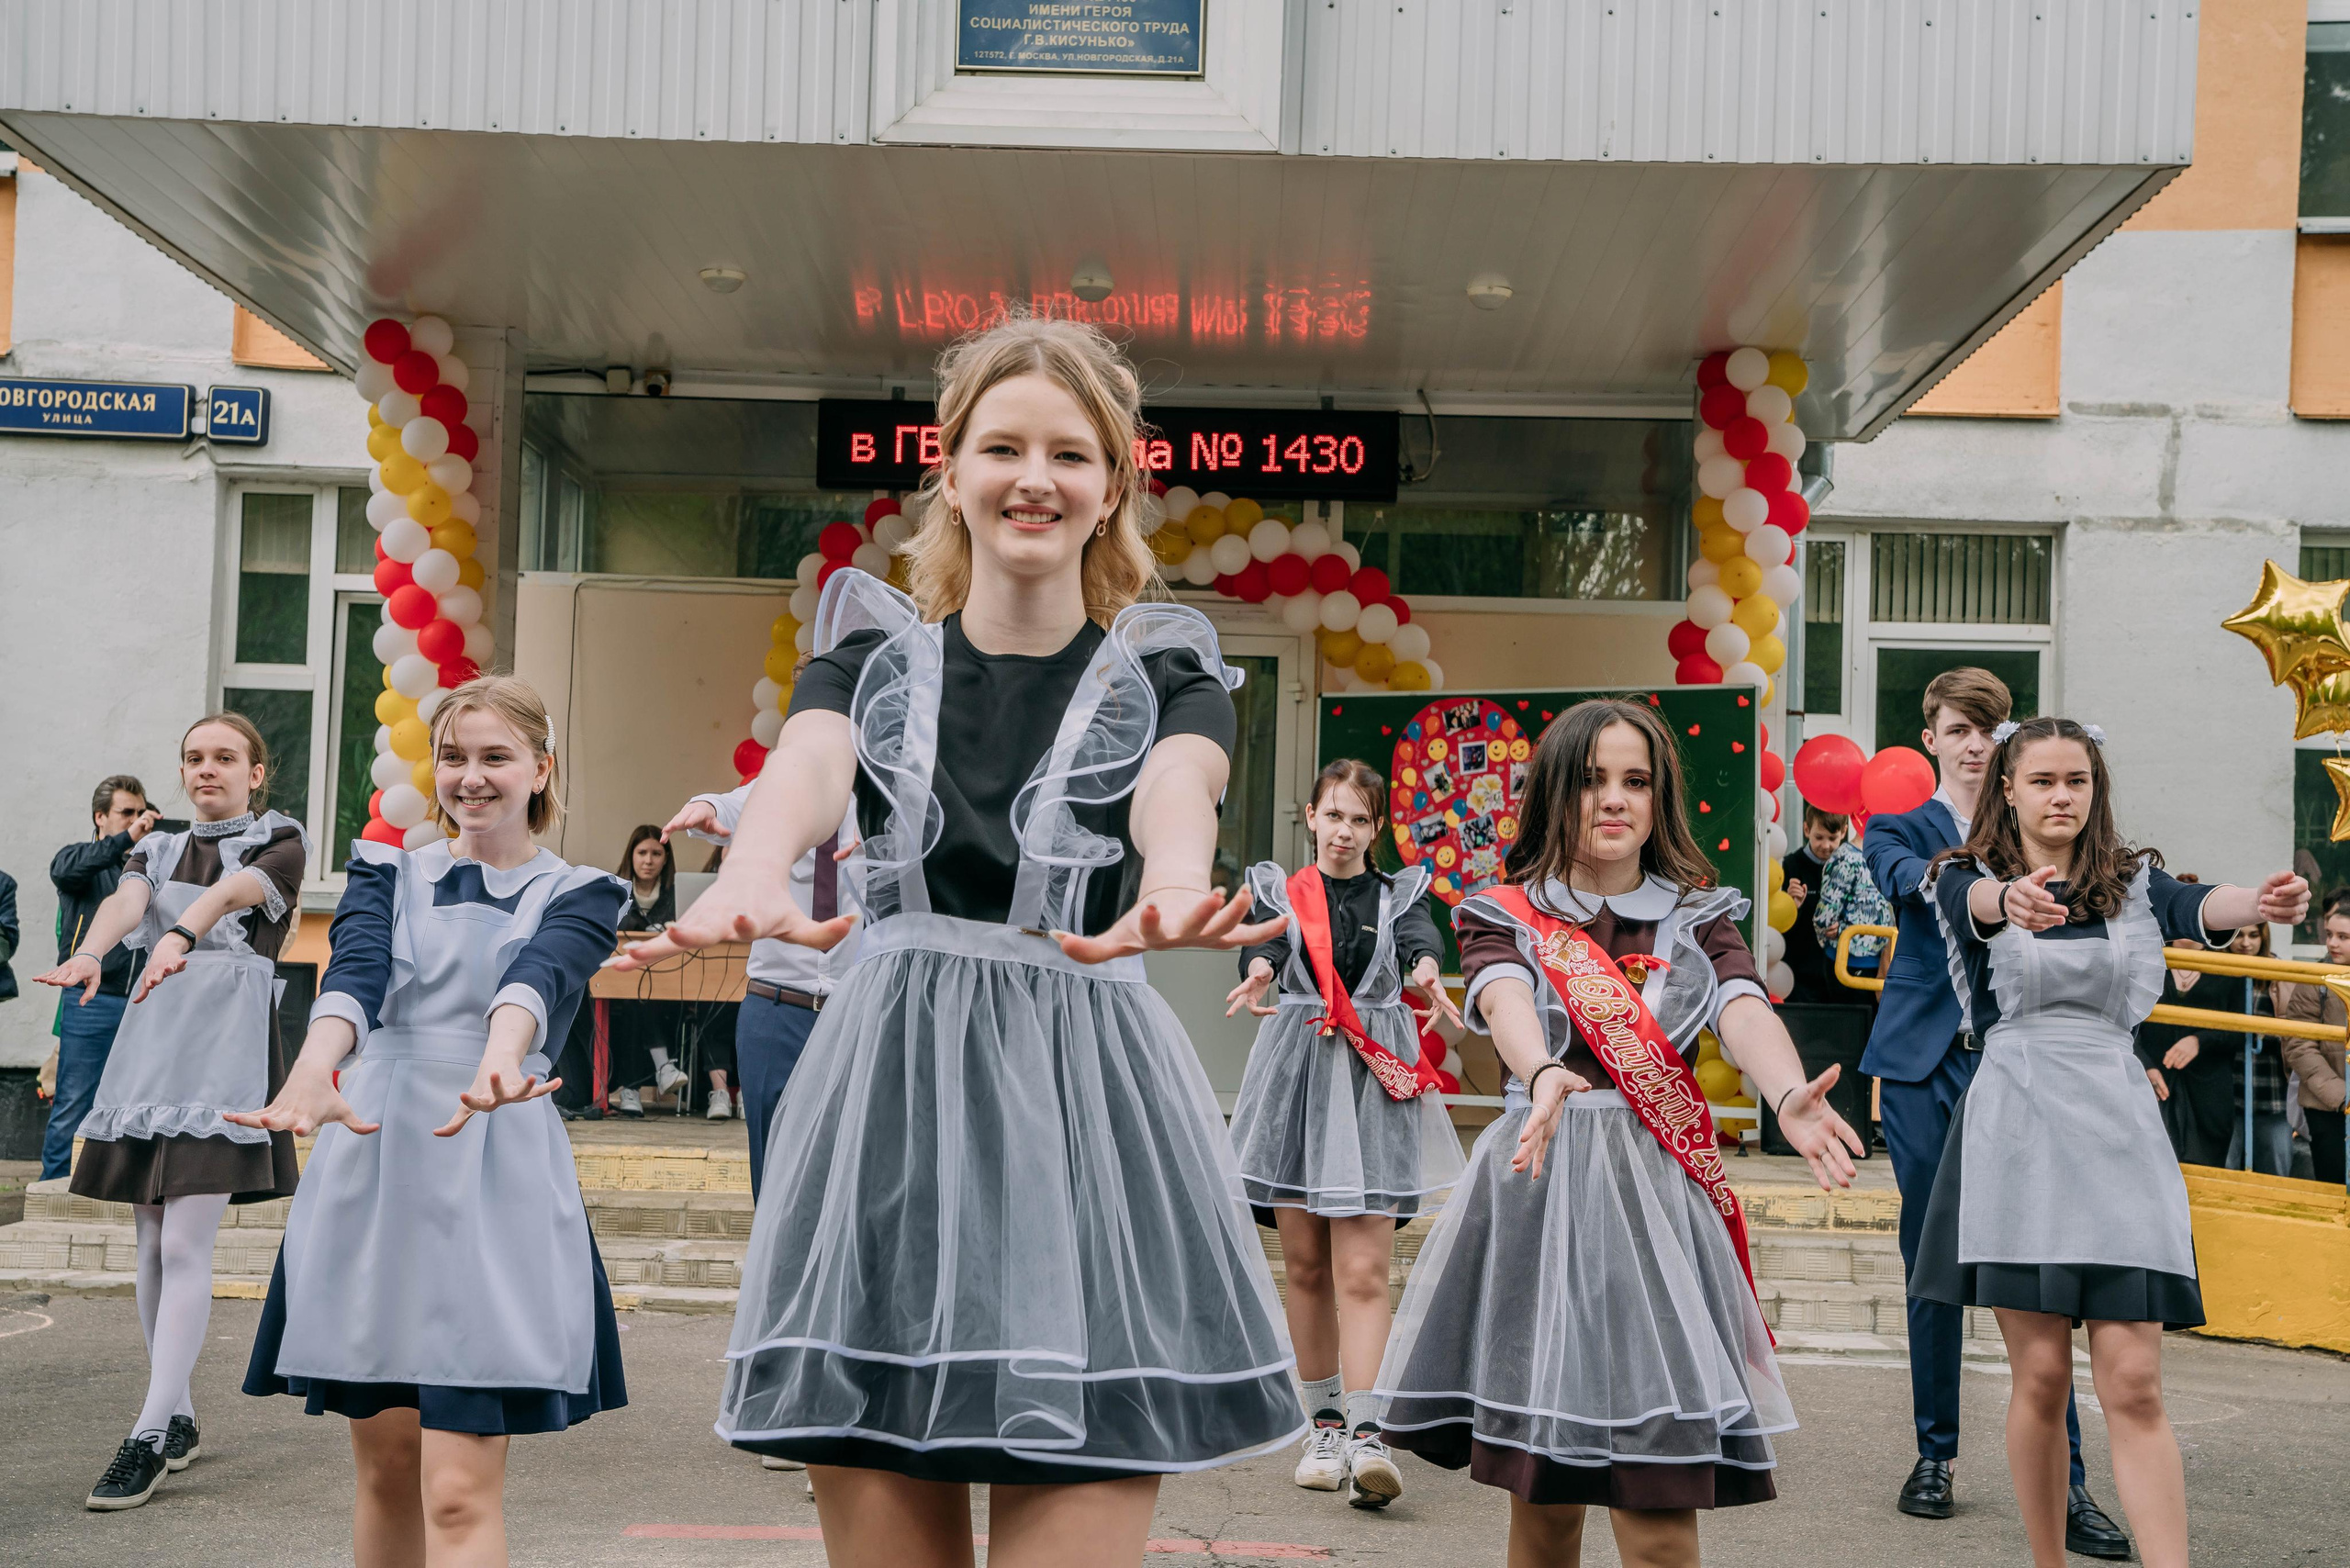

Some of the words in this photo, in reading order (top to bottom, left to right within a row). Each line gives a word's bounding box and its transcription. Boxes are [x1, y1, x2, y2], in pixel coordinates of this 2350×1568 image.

[1029, 4, 1080, 16] ИМЕНИ
[1084, 6, 1132, 17] ГЕРОЯ
[970, 17, 1139, 33] СОЦИАЛИСТИЧЕСКОГО
[1143, 22, 1190, 36] ТРУДА
[0, 386, 156, 411] ОВГОРОДСКАЯ
[42, 412, 93, 425] УЛИЦА
[213, 400, 256, 425] 21А
[852, 433, 875, 462] в
[895, 425, 943, 464] ГБ
[1192, 432, 1242, 470] №
[1262, 434, 1364, 473] 1430
[1566, 974, 1706, 1154] Выпускник
